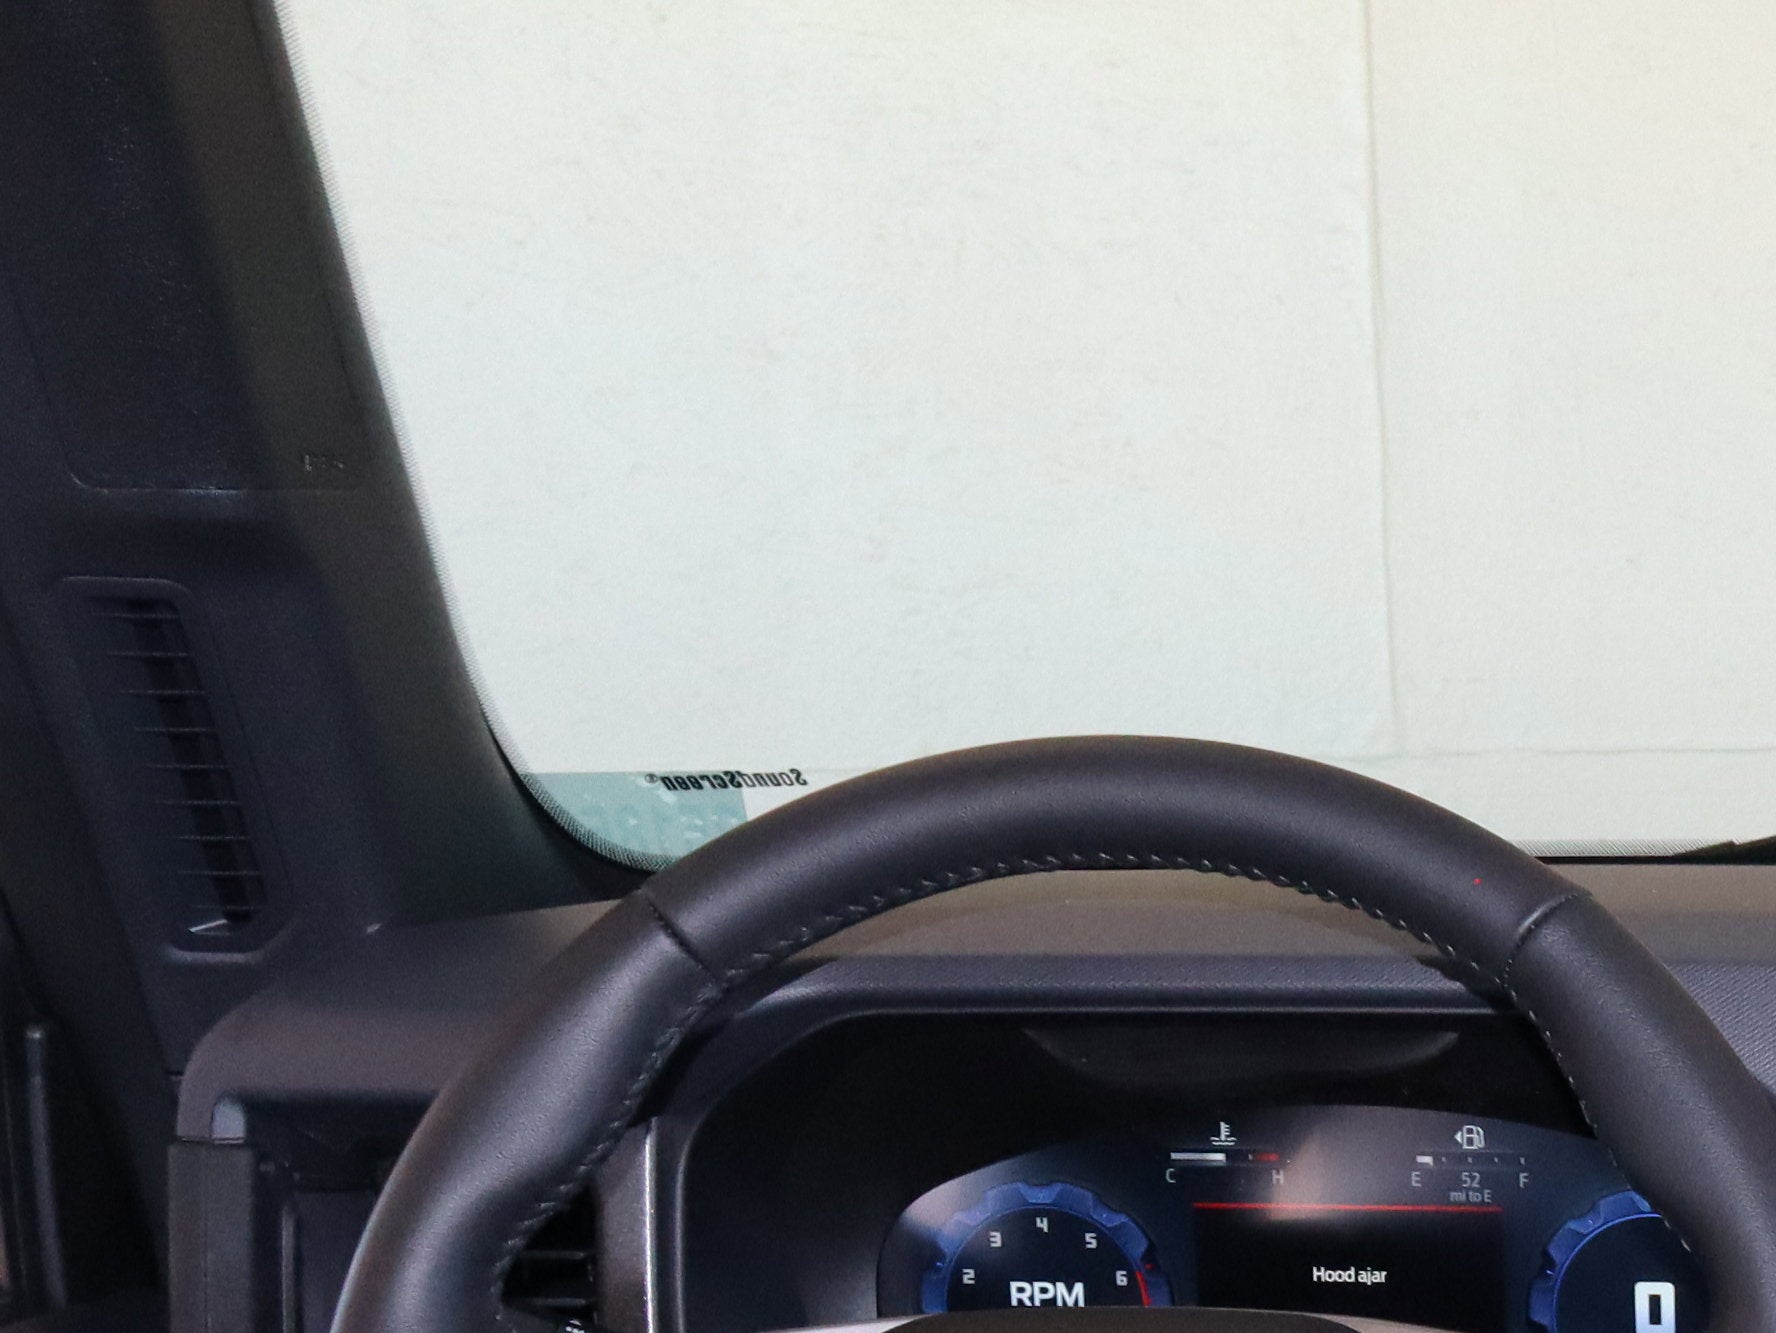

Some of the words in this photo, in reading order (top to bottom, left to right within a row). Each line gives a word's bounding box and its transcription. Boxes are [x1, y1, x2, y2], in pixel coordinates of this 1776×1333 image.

[1166, 1169, 1176, 1184] C
[1272, 1169, 1284, 1184] H
[1412, 1172, 1421, 1188] E
[1461, 1172, 1481, 1188] 52
[1520, 1173, 1528, 1188] F
[1450, 1189, 1466, 1202] mi
[1469, 1190, 1482, 1202] to
[1484, 1189, 1492, 1202] E
[1036, 1217, 1048, 1232] 4
[989, 1232, 1002, 1247] 3
[1085, 1233, 1097, 1248] 5
[963, 1269, 975, 1284] 2
[1115, 1270, 1128, 1286] 6
[1313, 1267, 1353, 1283] Hood
[1357, 1267, 1387, 1287] ajar
[1010, 1281, 1085, 1307] RPM
